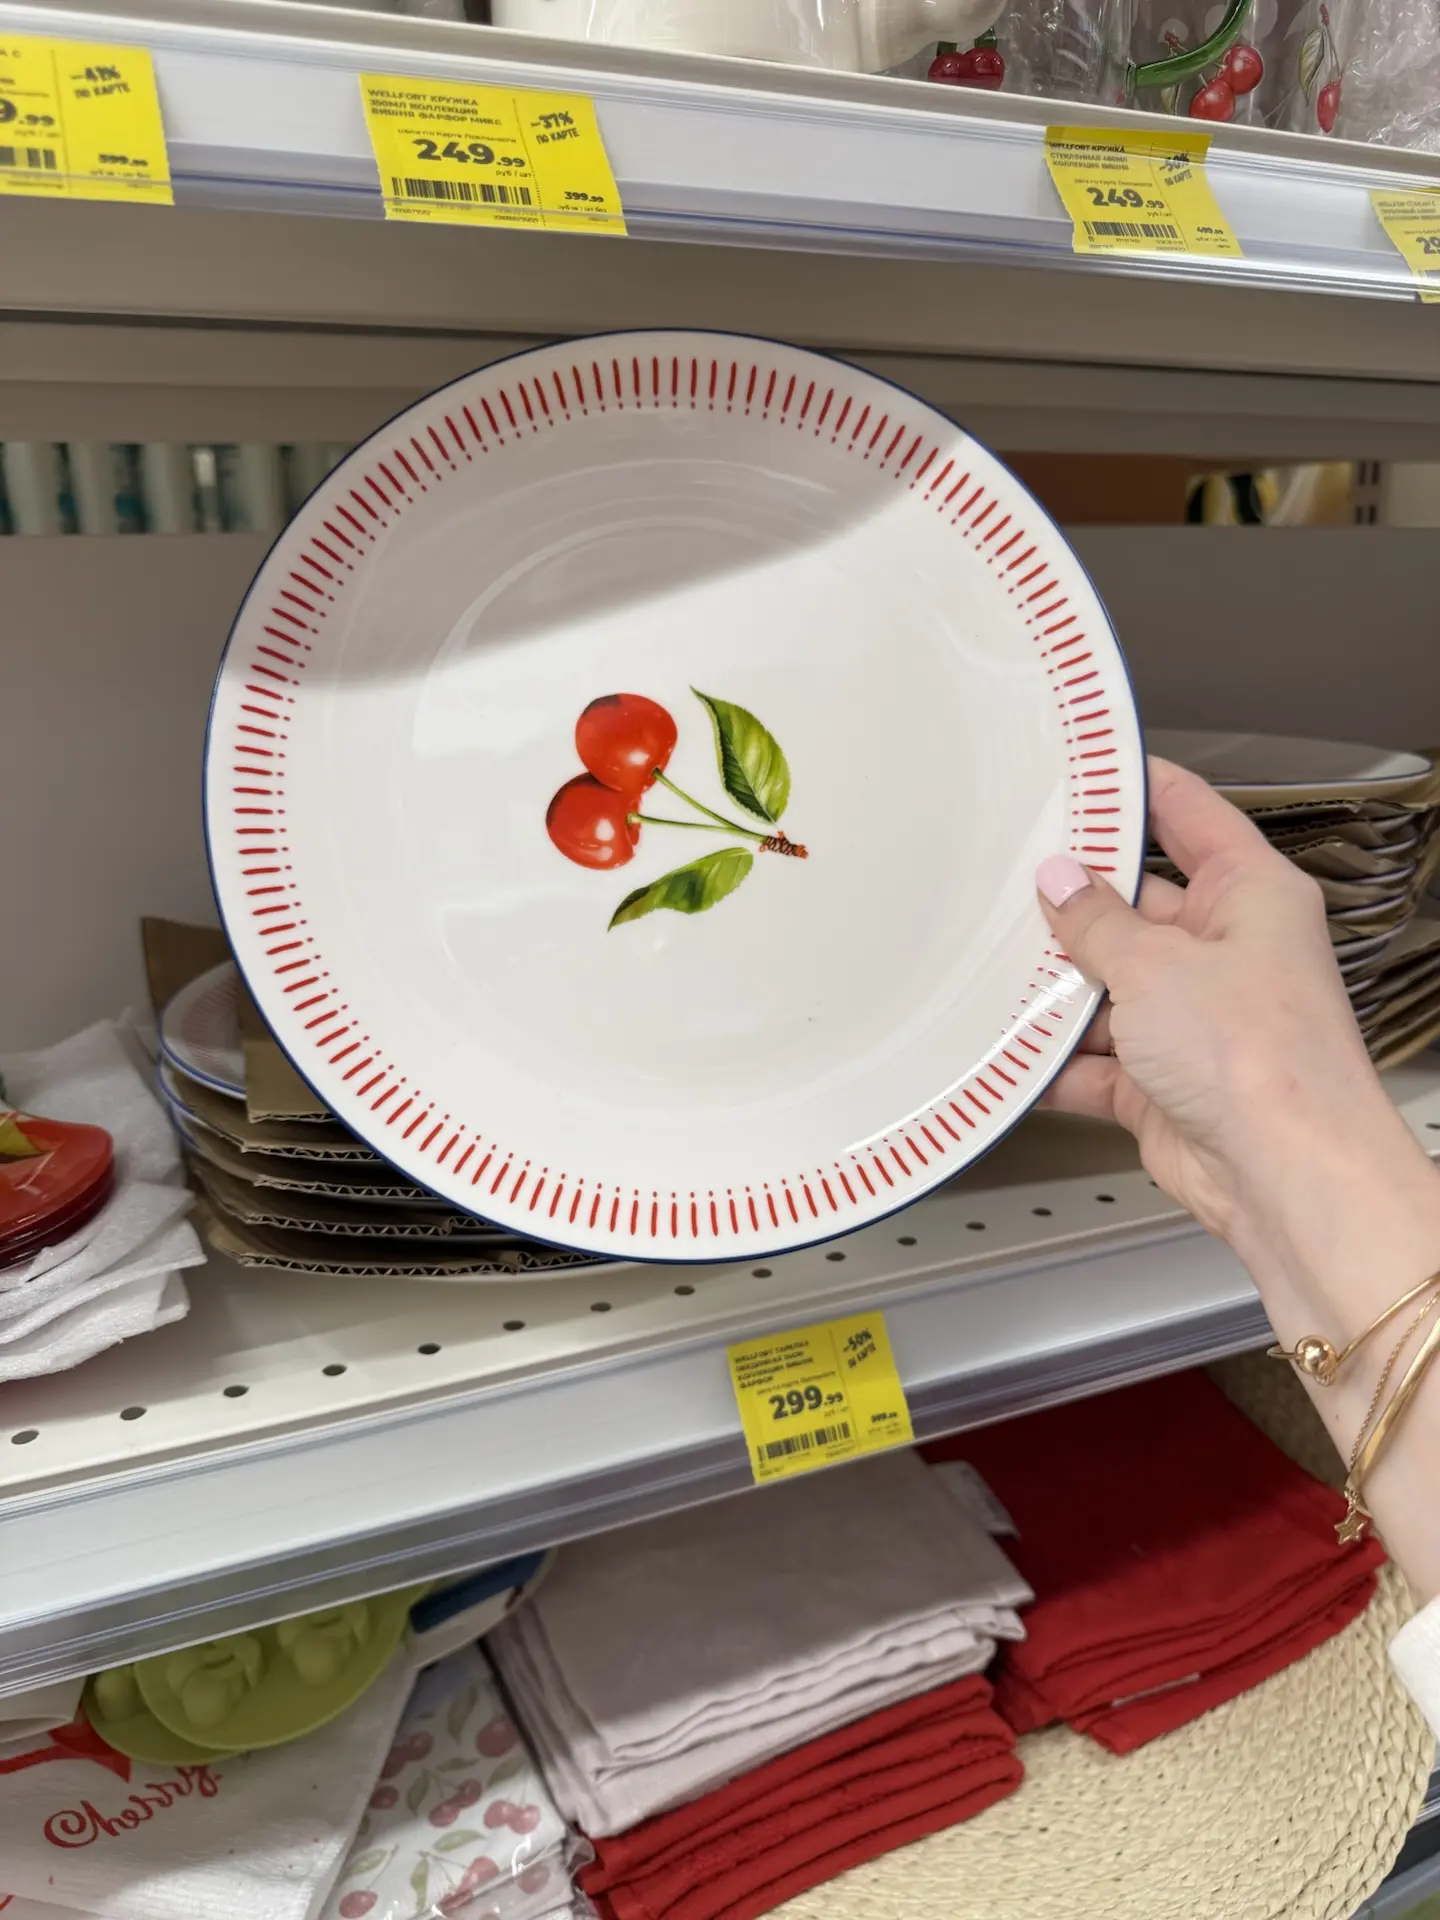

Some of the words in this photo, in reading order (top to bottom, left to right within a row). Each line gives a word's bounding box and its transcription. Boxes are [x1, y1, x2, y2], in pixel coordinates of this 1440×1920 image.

[368, 88, 427, 101] WELLFORT
[430, 95, 479, 106] КРУЖКА
[409, 103, 479, 115] КОЛЛЕКЦИЯ
[418, 112, 467, 122] ФАРФОР
[530, 111, 574, 129] -37%
[536, 134, 549, 145] ПО
[550, 127, 580, 142] КАРТЕ
[412, 138, 525, 167] 249.99
[1049, 142, 1090, 151] WELLFORT
[1091, 143, 1125, 153] КРУЖКА
[563, 190, 604, 203] 399.99
[1086, 187, 1165, 208] 249.99
[768, 1385, 844, 1420] 299.99
[44, 1764, 219, 1849] Cherry
